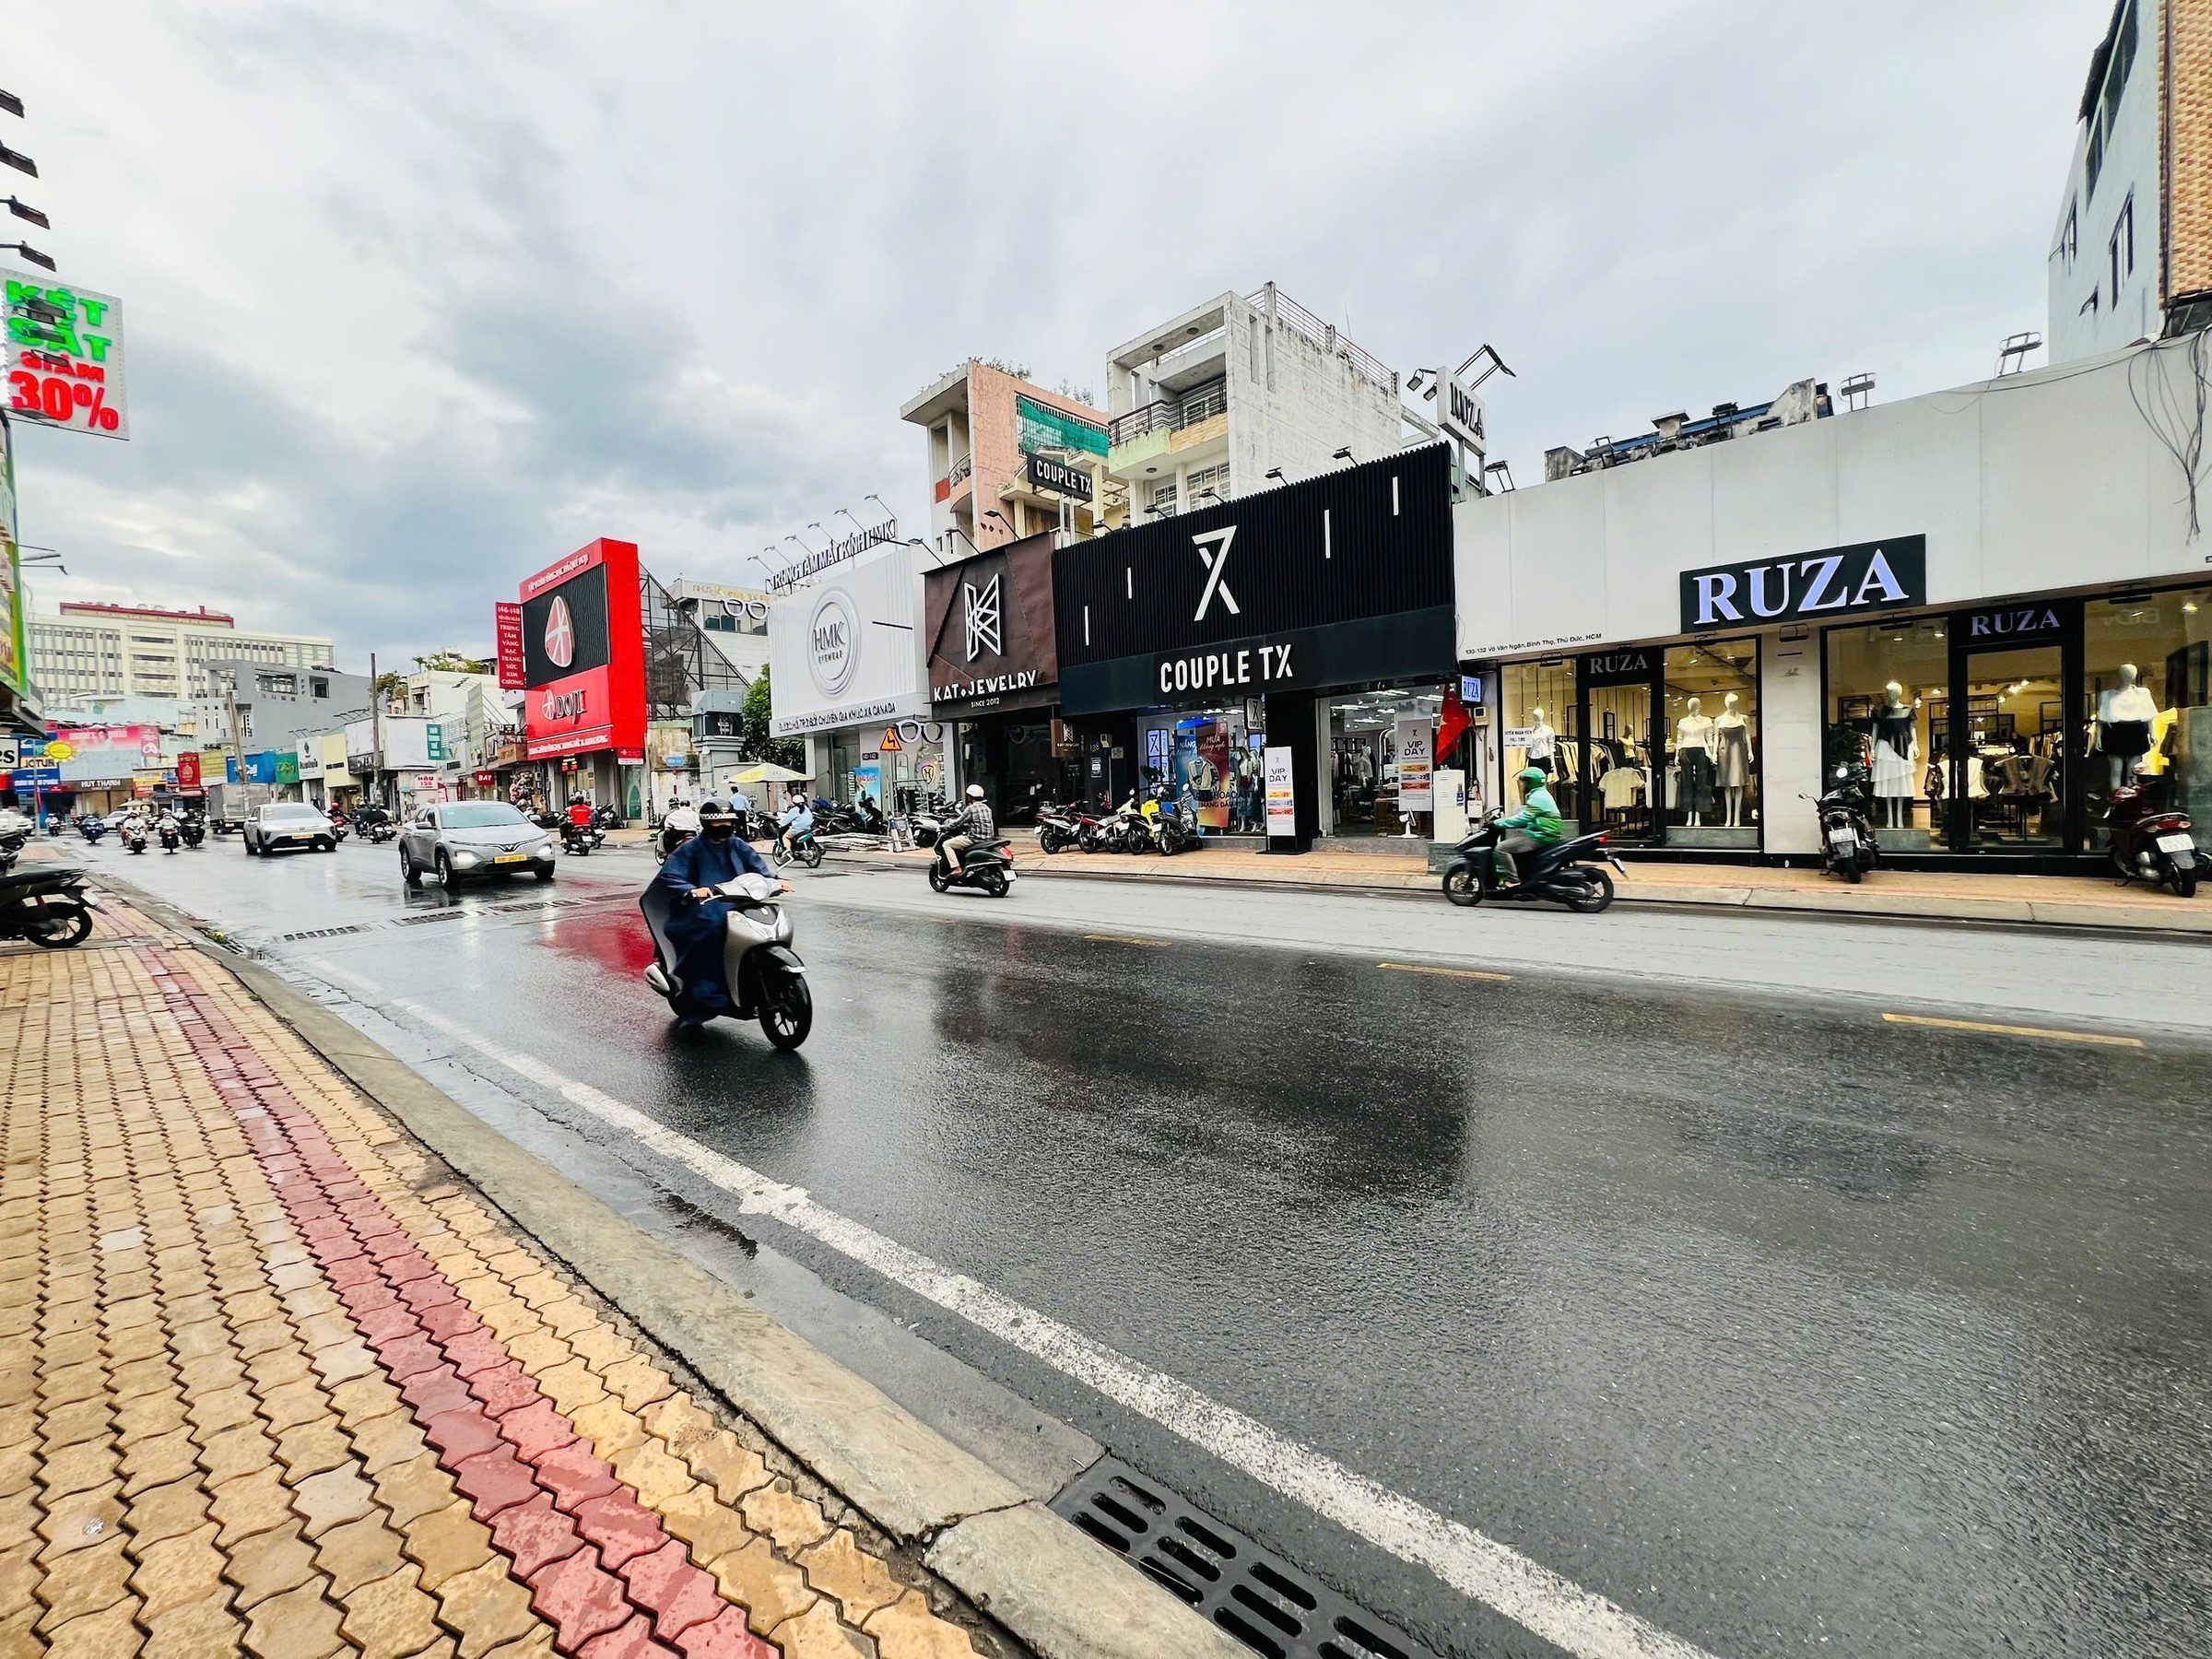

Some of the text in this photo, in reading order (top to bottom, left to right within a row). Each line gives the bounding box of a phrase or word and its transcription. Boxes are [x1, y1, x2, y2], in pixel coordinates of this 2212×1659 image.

[9, 371, 119, 430] 30%
[1450, 382, 1485, 440] RUZA
[1036, 460, 1092, 494] COUPLE TX
[1693, 548, 1909, 625] RUZA
[813, 621, 846, 652] HMK
[1585, 632, 1602, 641] HCM
[1971, 608, 2061, 636] RUZA
[1160, 644, 1293, 693] COUPLE TX
[1590, 653, 1649, 675] RUZA
[934, 670, 1038, 702] KAT JEWELRY
[1463, 681, 1479, 700] RUZA
[971, 700, 985, 708] SINCE
[1406, 740, 1424, 748] VIP
